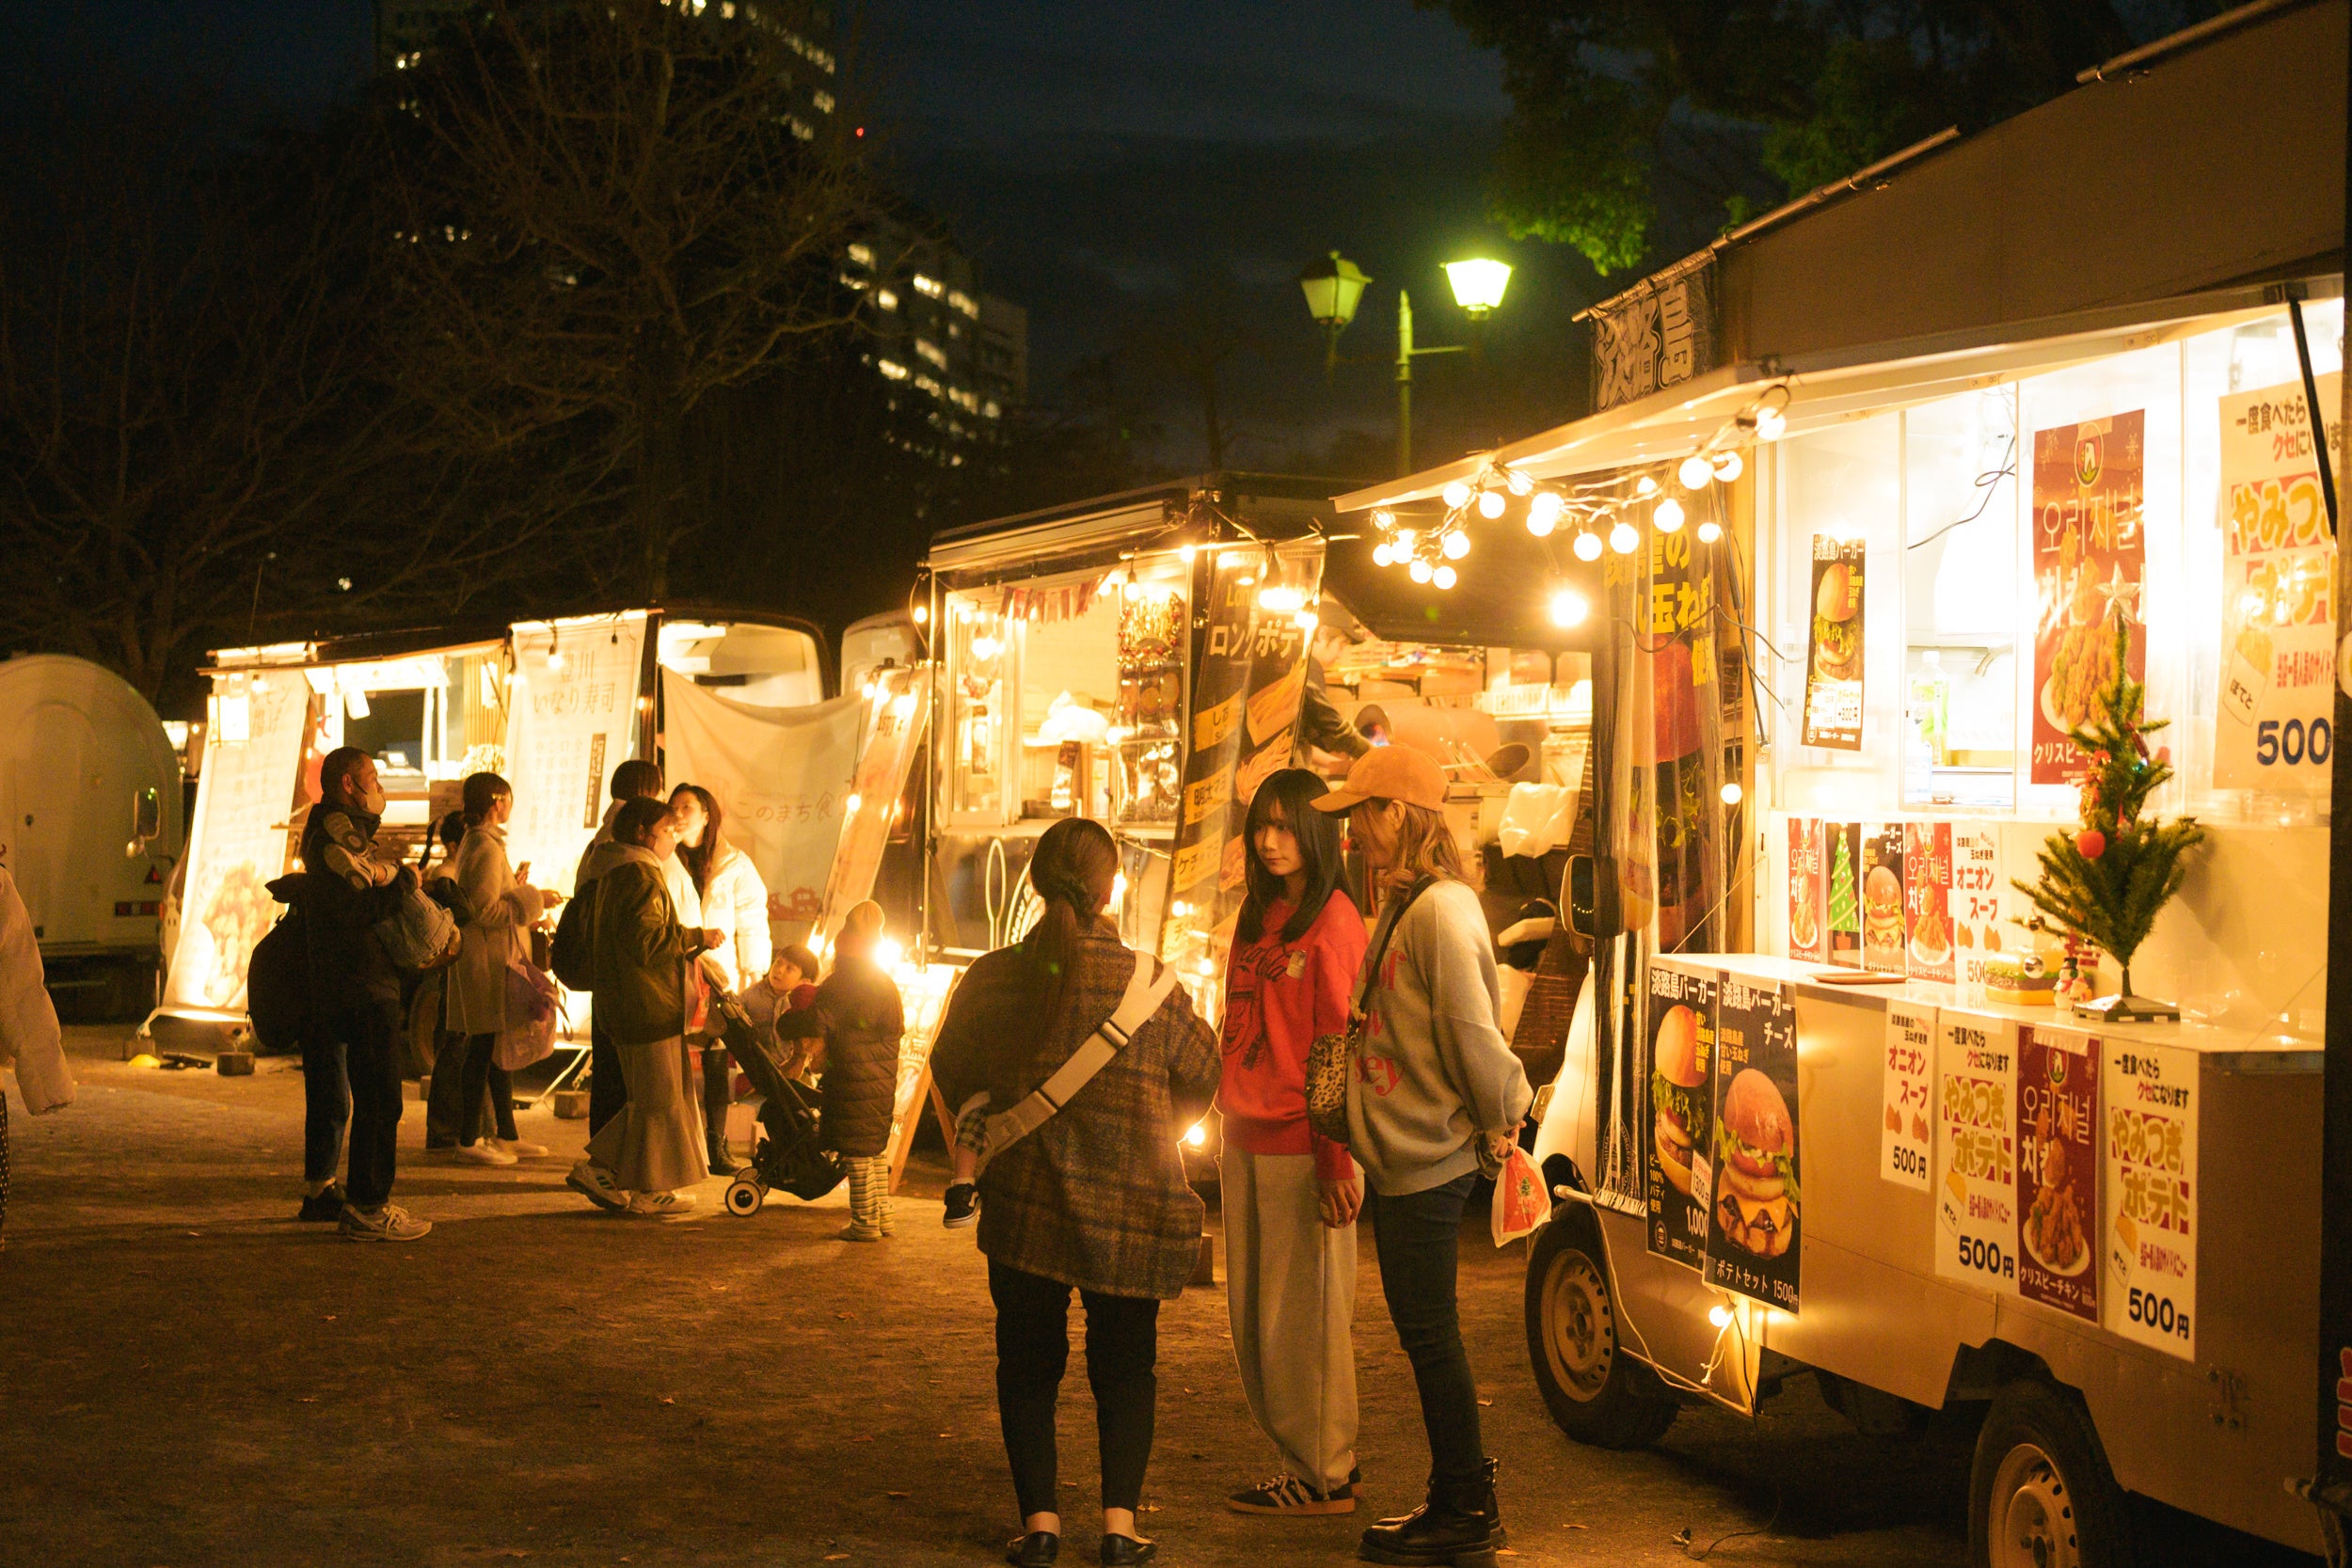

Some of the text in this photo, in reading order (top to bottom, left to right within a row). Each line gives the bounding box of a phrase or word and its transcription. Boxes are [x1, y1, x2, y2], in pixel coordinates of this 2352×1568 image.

[2235, 395, 2306, 436] 一度食べたら
[2042, 483, 2137, 557] 오리지널
[2233, 478, 2335, 552] やみつ
[533, 682, 615, 715] いなり寿司
[2033, 742, 2091, 765] クリスピー
[2257, 718, 2331, 766] 500
[1957, 865, 1994, 891] オニオン
[1651, 969, 1717, 1005] 淡路島バーガー
[1764, 1022, 1793, 1050] チーズ
[1947, 1026, 1986, 1048] 一度食べたら
[1888, 1044, 1926, 1076] オニオン
[1967, 1049, 2010, 1073] クセになります
[2114, 1053, 2160, 1080] 一度食べたら
[1900, 1080, 1929, 1110] スープ
[1945, 1076, 2006, 1130] やみつき
[2137, 1081, 2189, 1110] クセになります
[2022, 1085, 2090, 1145] 오리지널
[1954, 1130, 2010, 1182] ポテト
[2112, 1110, 2184, 1172] やみつき
[1893, 1145, 1926, 1180] 500円
[2123, 1171, 2189, 1231] ポテト
[1959, 1234, 2014, 1279] 500円
[1717, 1259, 1768, 1293] ポテトセット
[2021, 1265, 2080, 1301] クリスピーチキン
[2128, 1286, 2189, 1340] 500円
